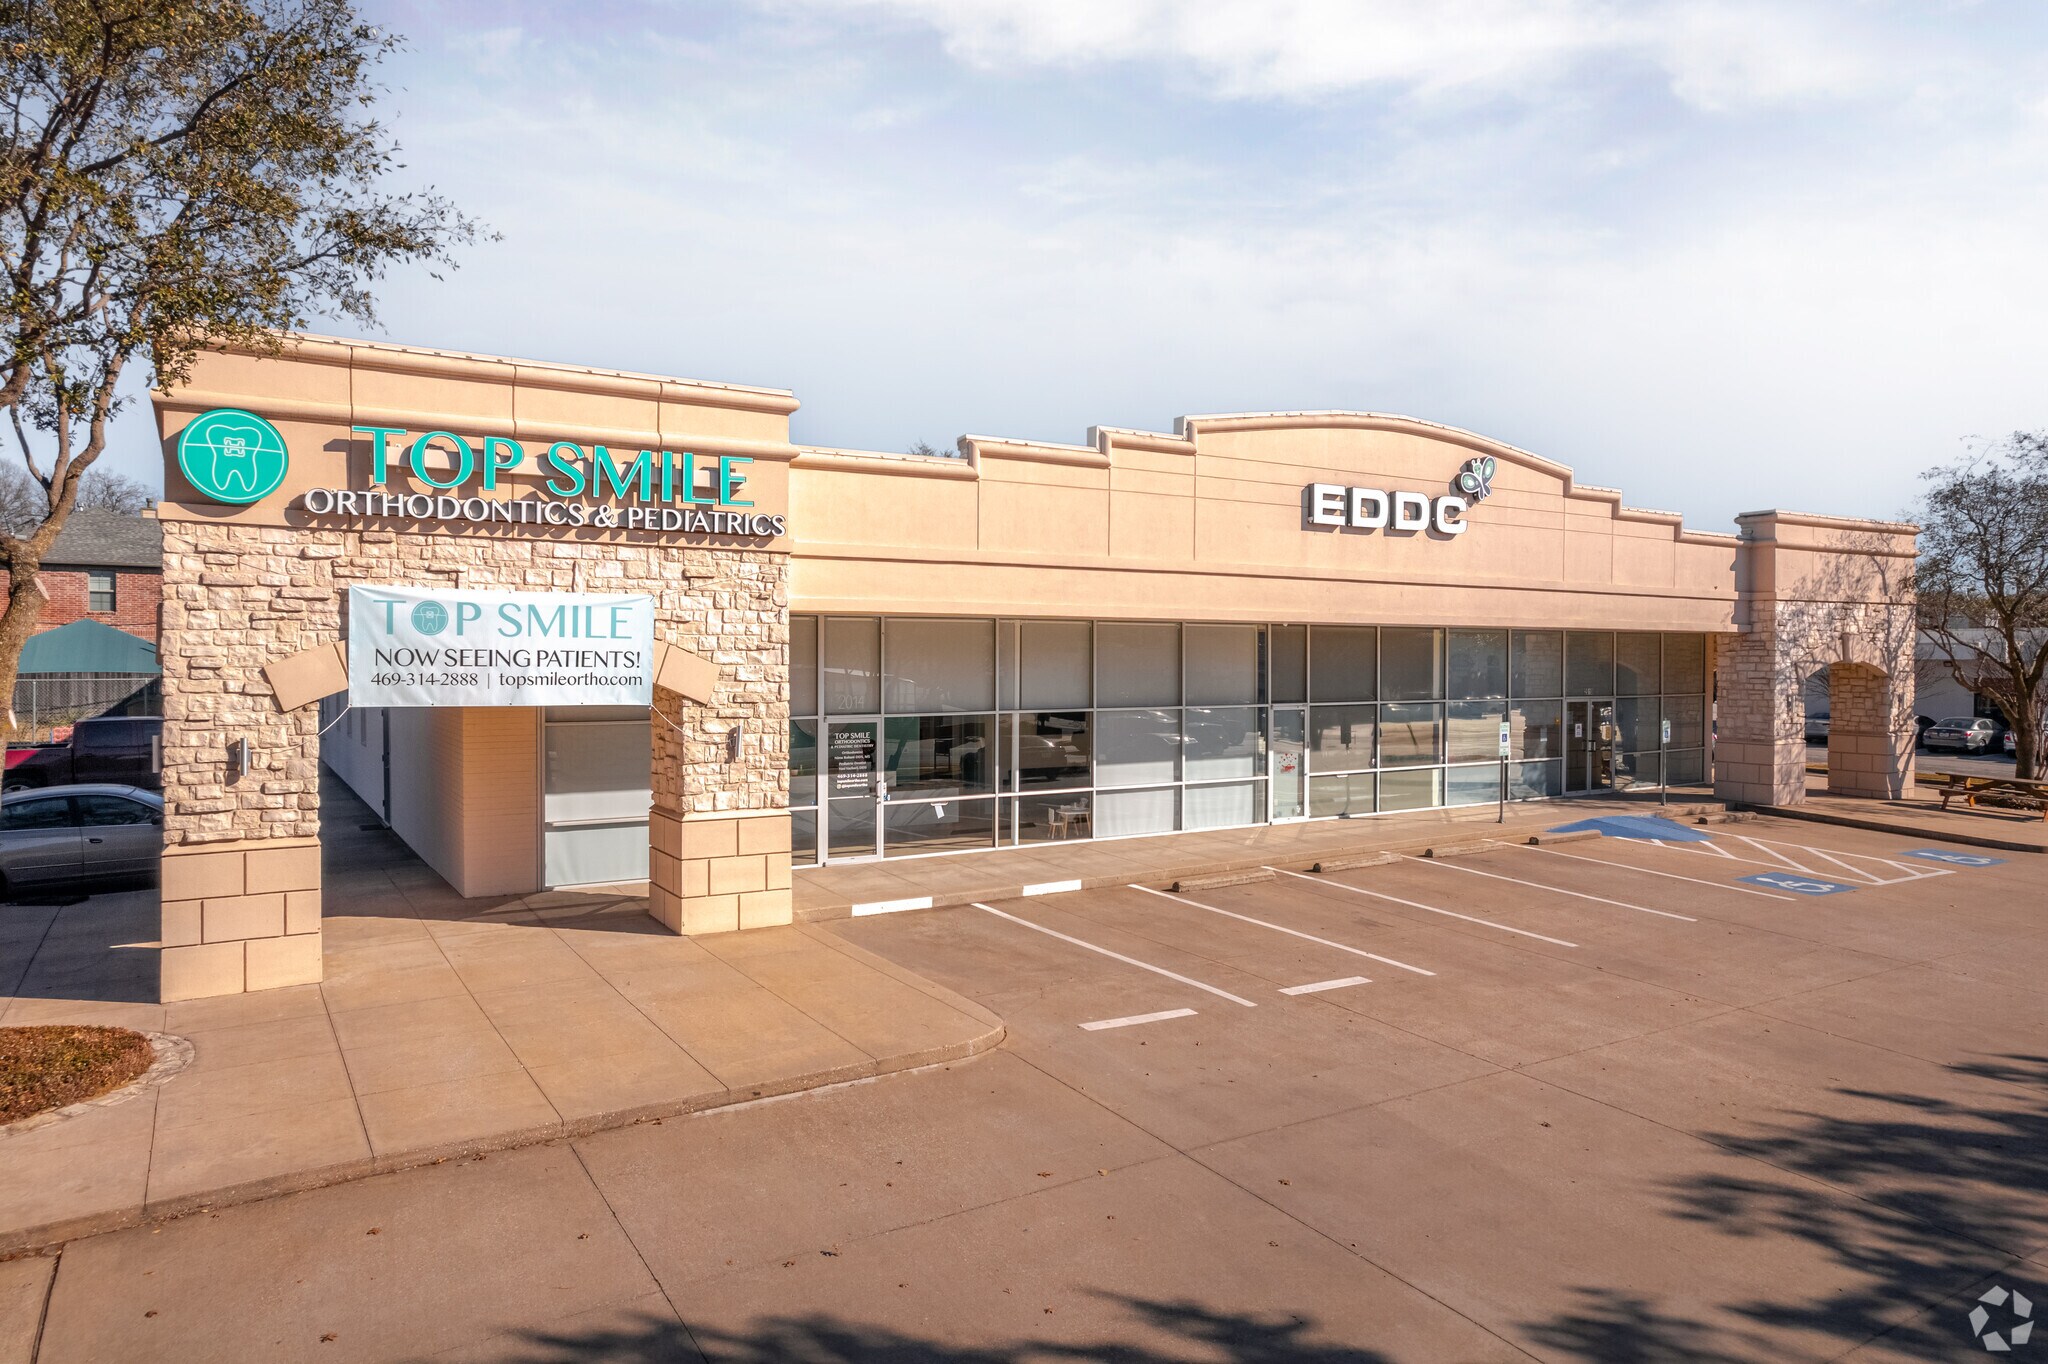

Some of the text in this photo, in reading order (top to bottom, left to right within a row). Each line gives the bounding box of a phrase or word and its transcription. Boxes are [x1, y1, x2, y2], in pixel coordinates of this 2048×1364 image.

[351, 425, 754, 507] TOP SMILE
[304, 488, 786, 537] ORTHODONTICS & PEDIATRICS
[1312, 483, 1468, 534] EDDC
[497, 603, 633, 639] SMILE
[375, 648, 641, 668] NOW SEEING PATIENTS!
[371, 672, 478, 686] 469-314-2888
[499, 672, 643, 689] topsmileortho.com
